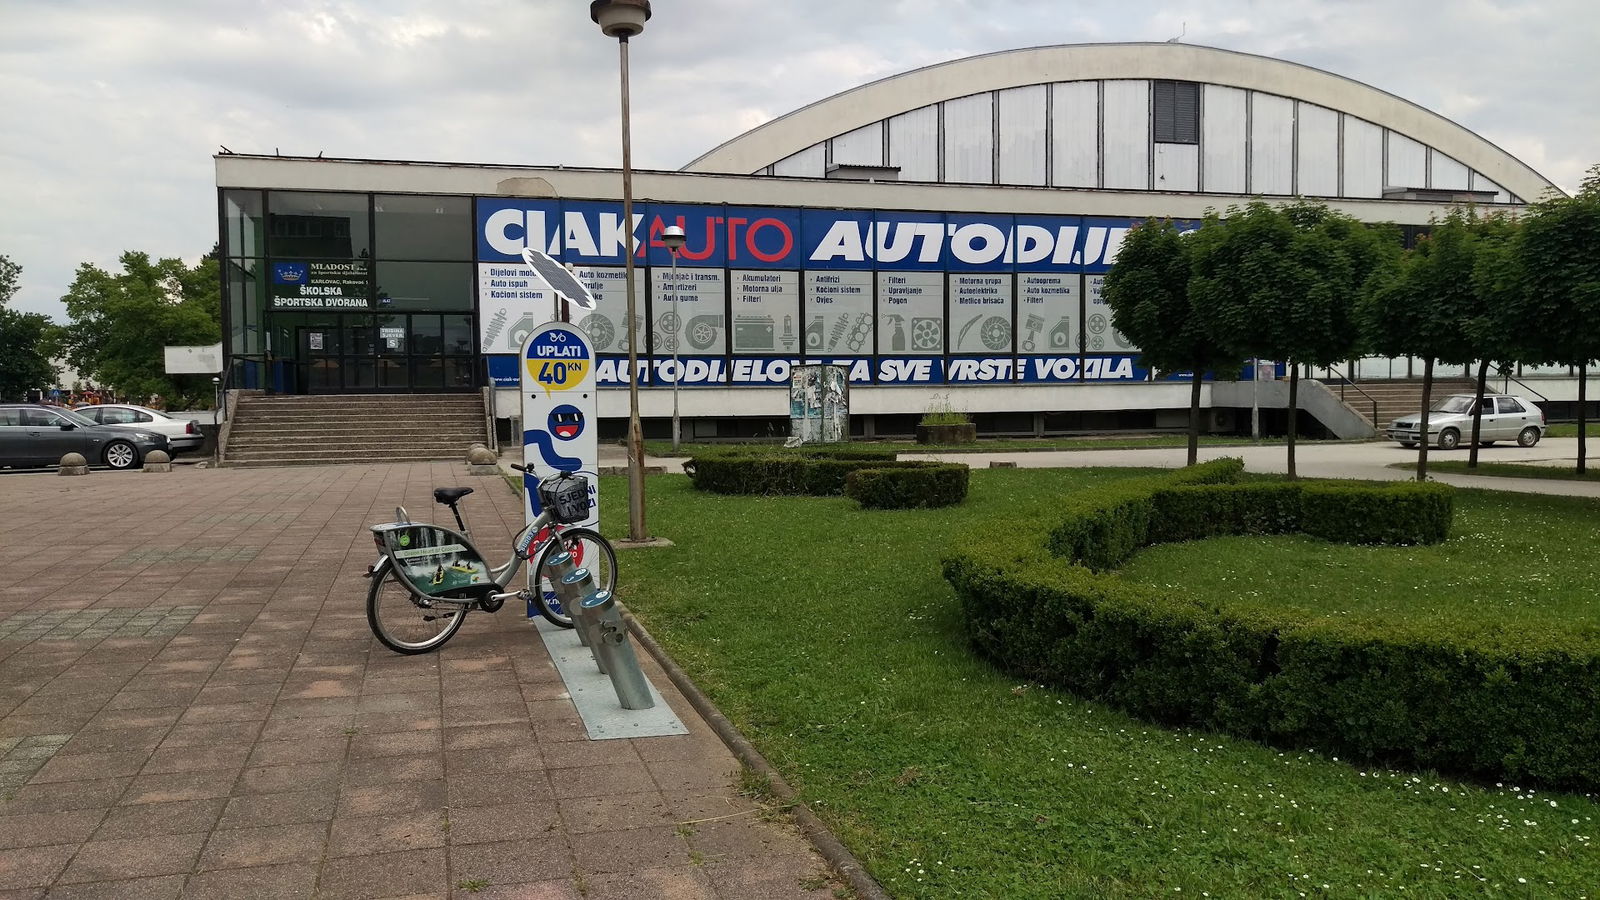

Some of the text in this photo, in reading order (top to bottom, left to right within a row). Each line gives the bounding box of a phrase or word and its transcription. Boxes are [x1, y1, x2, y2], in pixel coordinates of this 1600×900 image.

[311, 263, 354, 271] MLADOST
[490, 268, 517, 277] Dijelovi
[579, 271, 628, 279] Auto kozmetik
[695, 273, 720, 281] transm.
[742, 274, 781, 282] Akumulatori
[816, 275, 840, 283] Antifrizi
[888, 276, 906, 284] Filteri
[959, 277, 1002, 286] Motorna grupa
[1026, 277, 1061, 286] Autooprema
[491, 279, 528, 288] Auto ispuh
[581, 281, 604, 290] arulje
[300, 284, 343, 296] ŠKOLSKA
[742, 284, 783, 293] Motorna ulja
[816, 285, 861, 294] Kočioni sistem
[888, 287, 923, 296] Upravljanje
[491, 290, 543, 299] Kočioni sistem
[680, 294, 699, 302] gume
[742, 295, 762, 303] Filteri
[274, 296, 368, 307] ŠPORTSKA DVORANA
[816, 296, 834, 305] Ovjes
[888, 297, 908, 305] Pogon
[959, 297, 982, 305] Metlice
[1026, 296, 1044, 304] Filteri
[389, 339, 396, 347] S
[537, 345, 581, 357] UPLATI
[538, 361, 582, 384] 40 KN
[878, 359, 933, 382] SVE
[941, 359, 1028, 381] VRSTE
[1034, 358, 1133, 380] VOZILA
